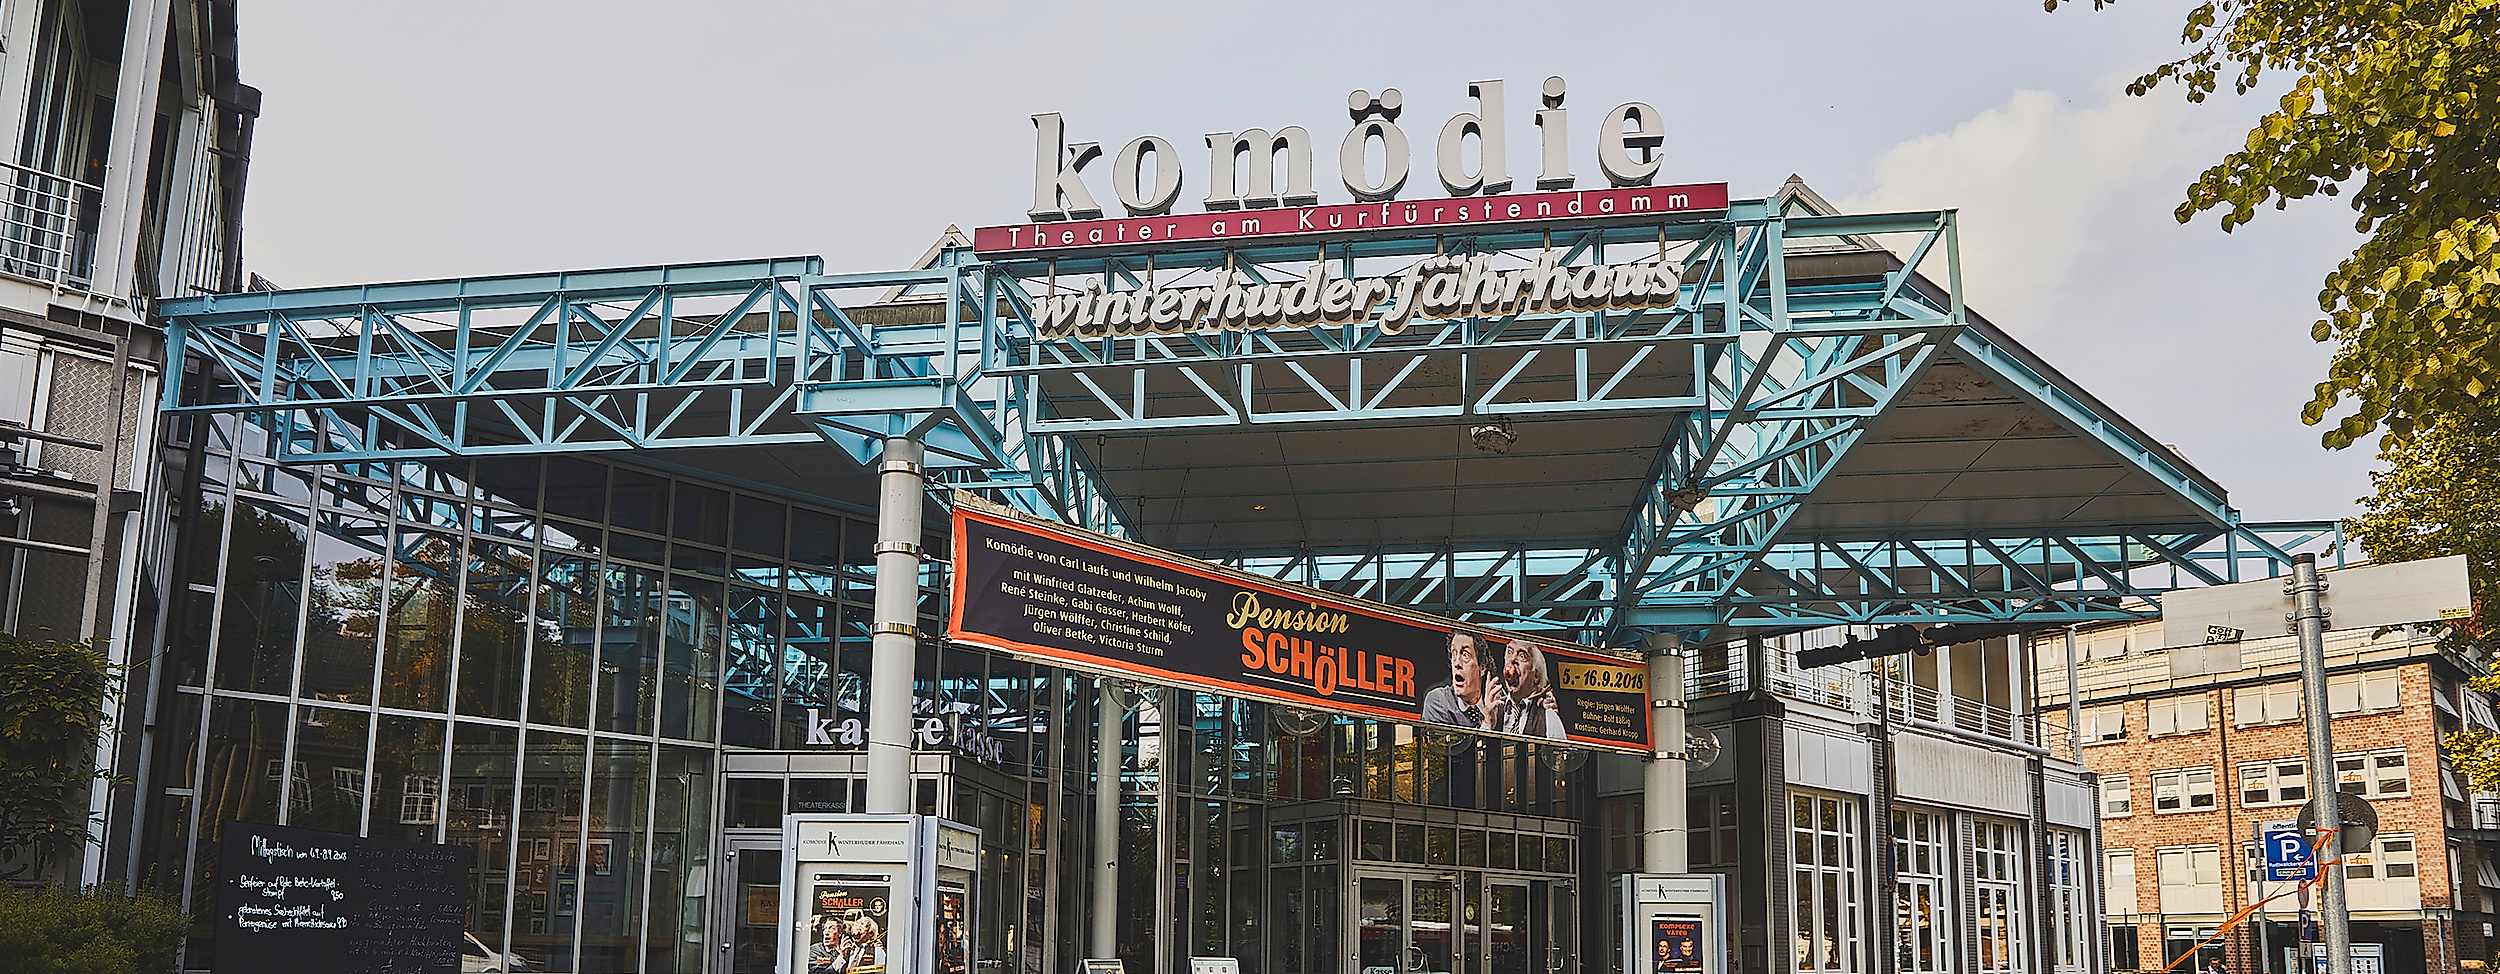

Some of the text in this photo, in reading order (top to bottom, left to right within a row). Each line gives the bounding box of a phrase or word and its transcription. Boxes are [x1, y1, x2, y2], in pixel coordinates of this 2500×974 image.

[1027, 75, 1667, 222] komödie
[1008, 190, 1690, 248] Theater am Kurfürstendamm
[1031, 250, 1687, 342] winterhuder fährhaus
[985, 537, 1207, 603] Komödie von Carl Laufs und Wilhelm Jacoby
[1001, 582, 1195, 636] René Steinke, Gabi Gasser, Herbert Köfer,
[1013, 569, 1184, 619] mit Winfried Glatzeder, Achim Wolff,
[1226, 590, 1350, 634] Pension
[1023, 603, 1173, 646] Jürgen Wölffer, Christine Schild,
[1033, 621, 1164, 657] Oliver Betke, Victoria Sturm
[1241, 627, 1416, 698] SCHÖLLER
[1576, 697, 1596, 709] Regie:
[1596, 701, 1615, 713] Jürgen
[1582, 710, 1603, 722] Bühne:
[806, 708, 1003, 765] kae kasse
[1599, 726, 1622, 736] Gerhard
[2280, 839, 2301, 862] P
[2301, 913, 2309, 937] P
